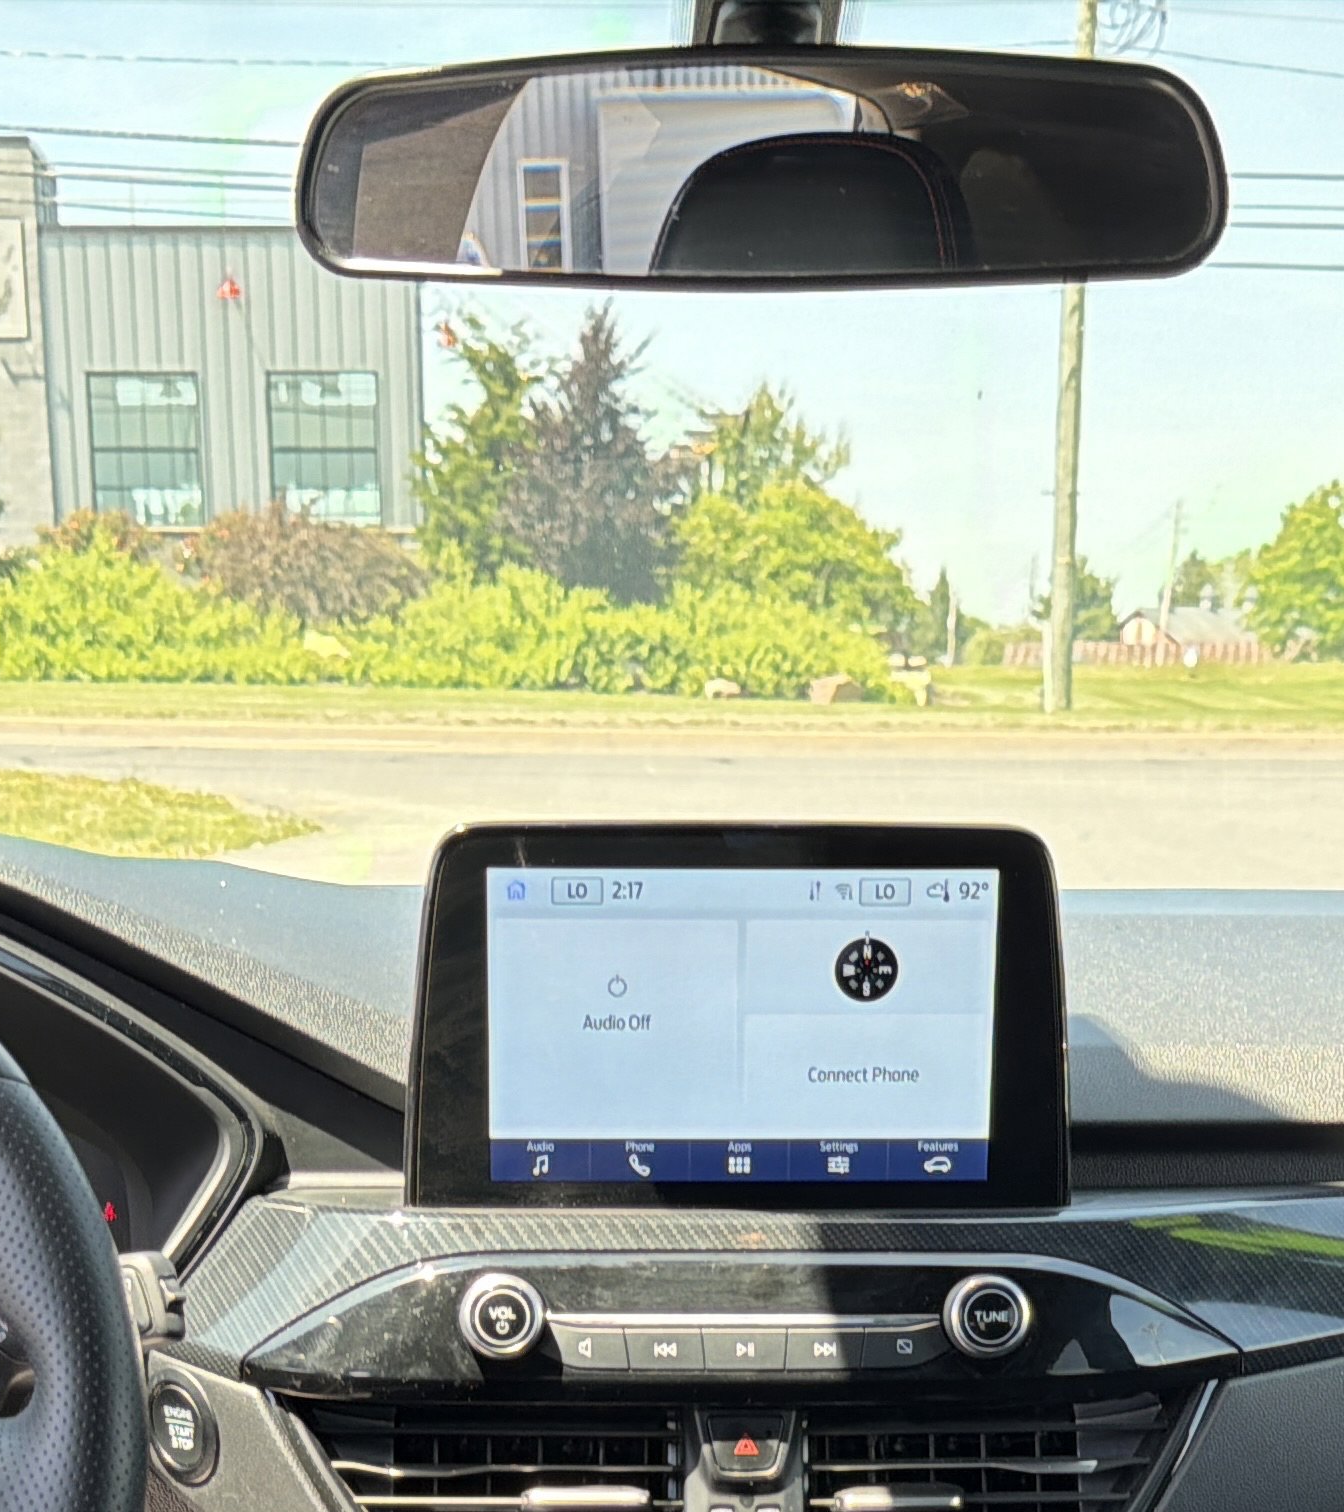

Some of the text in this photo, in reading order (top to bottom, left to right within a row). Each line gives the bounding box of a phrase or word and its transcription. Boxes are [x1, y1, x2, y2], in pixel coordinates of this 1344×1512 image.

[567, 882, 588, 900] LO
[611, 881, 644, 900] 2:17
[874, 883, 896, 900] LO
[958, 881, 990, 900] 92°
[582, 1014, 652, 1031] Audio Off
[807, 1066, 920, 1084] Connect Phone
[526, 1140, 555, 1152] Audio
[625, 1140, 655, 1152] Phone
[727, 1141, 752, 1154] Apps
[819, 1140, 859, 1154] Settings
[917, 1140, 959, 1152] Features
[488, 1305, 517, 1321] VOL
[974, 1310, 1009, 1323] TUNE
